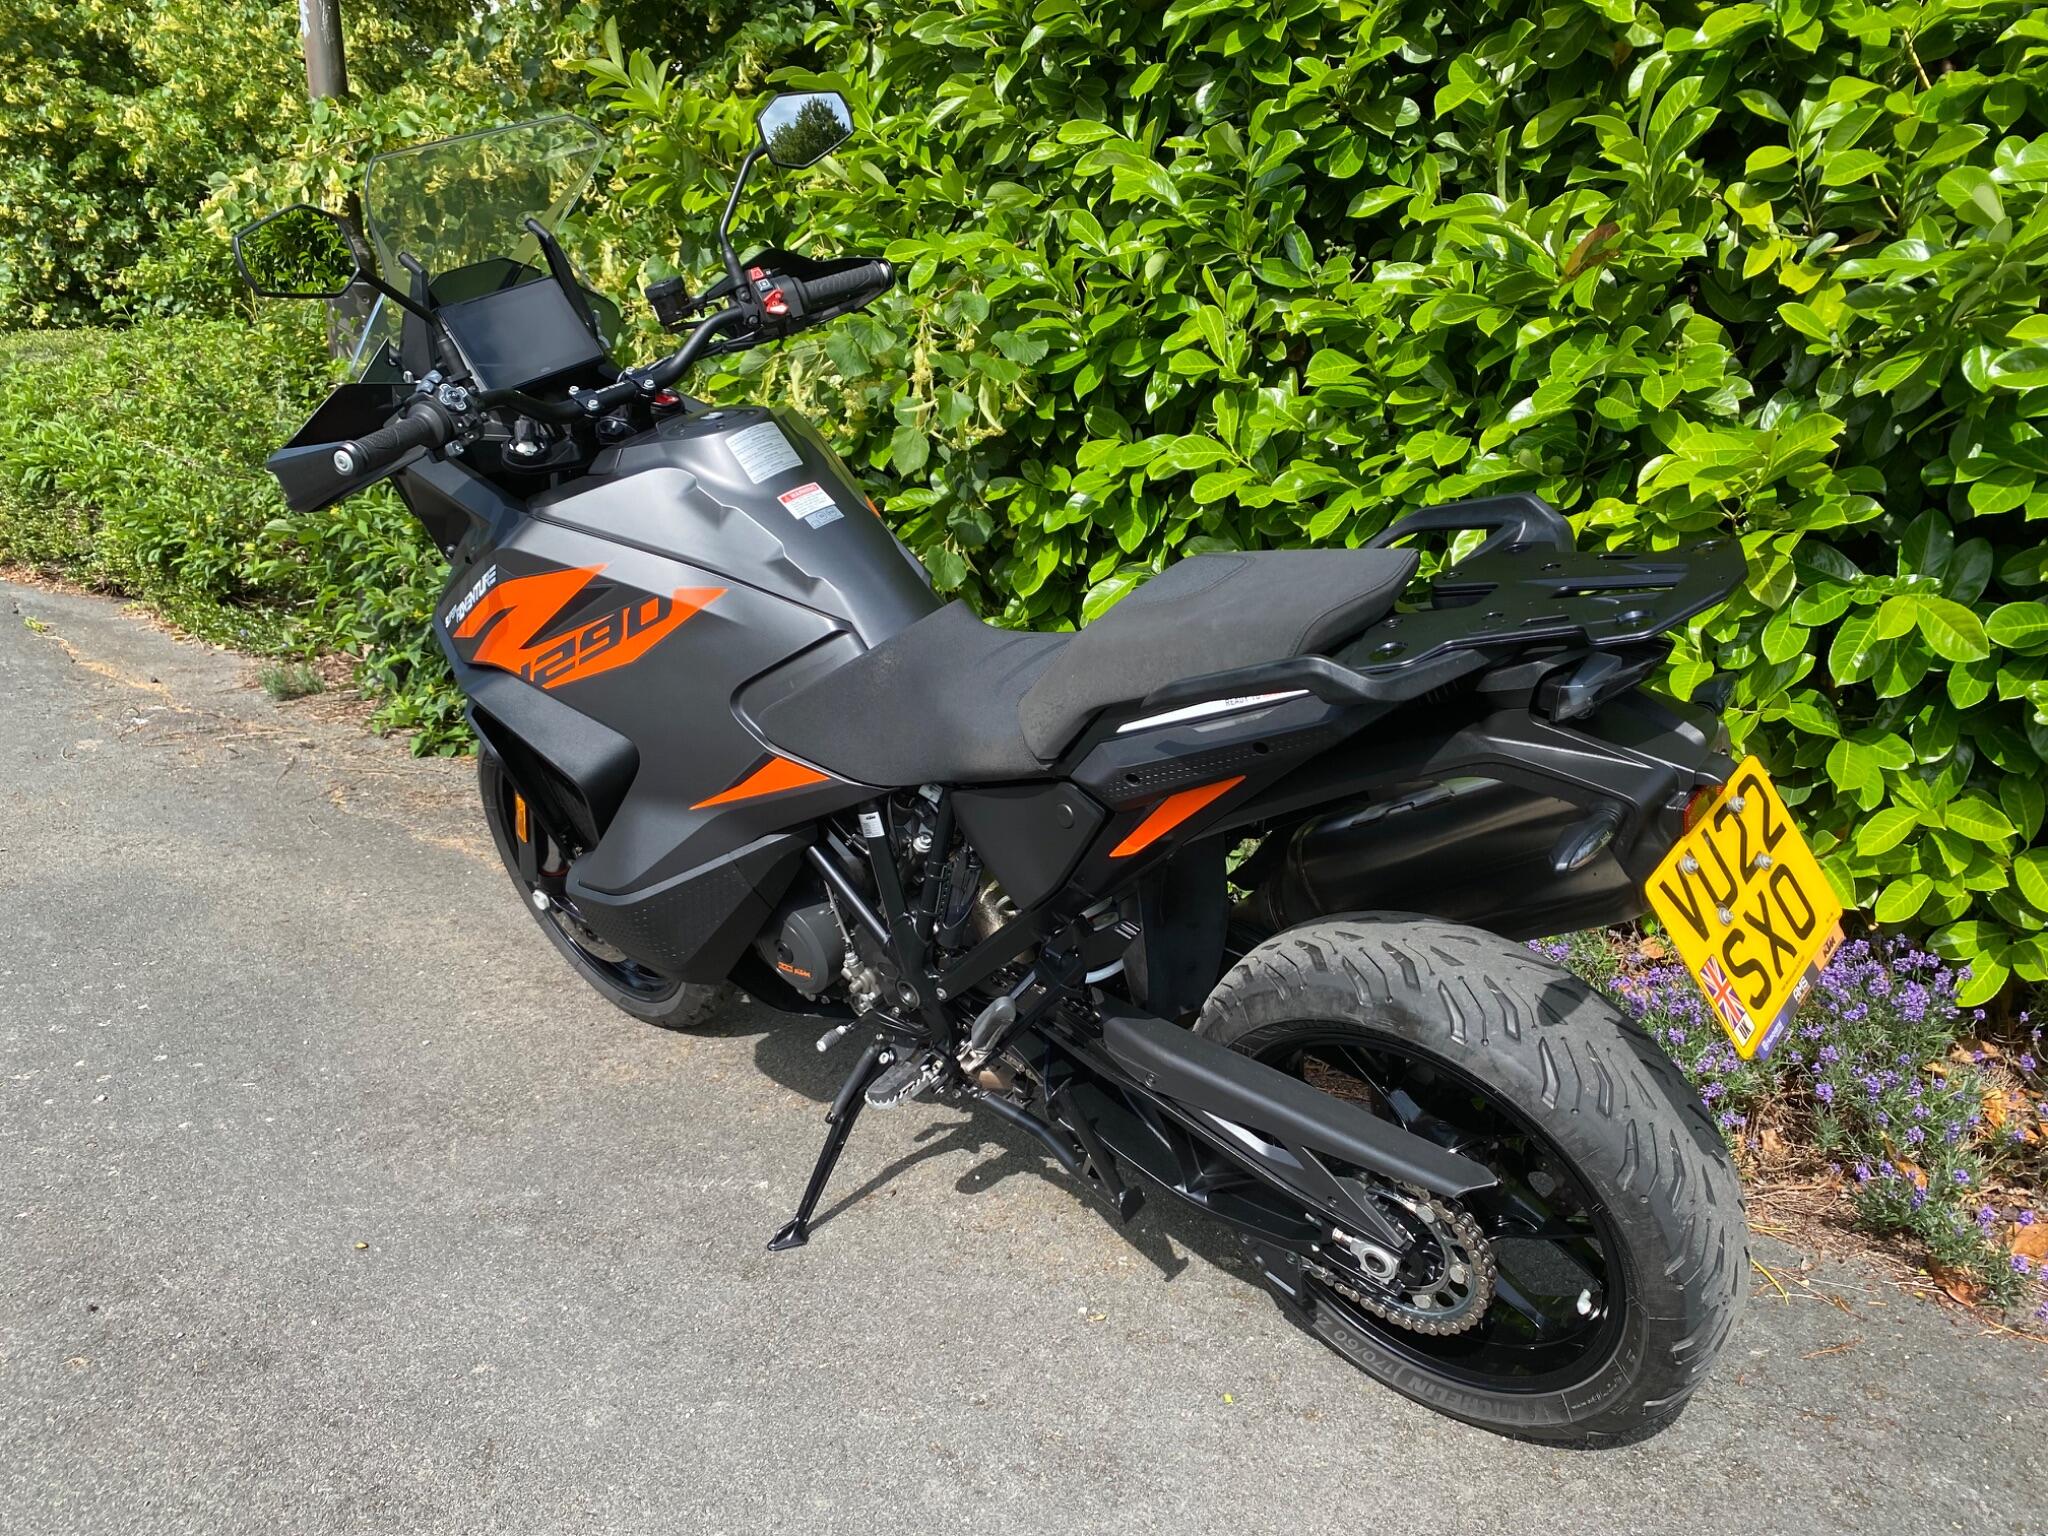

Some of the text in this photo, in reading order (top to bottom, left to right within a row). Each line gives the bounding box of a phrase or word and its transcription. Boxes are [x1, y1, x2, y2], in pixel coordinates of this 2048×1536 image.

[520, 595, 673, 685] 1290
[1659, 773, 1787, 942] VU22
[1722, 863, 1817, 1010] SXO
[1821, 936, 1836, 958] KTM
[1792, 976, 1809, 1000] AMS
[1737, 1019, 1751, 1039] UK
[1331, 1330, 1394, 1374] 170/60
